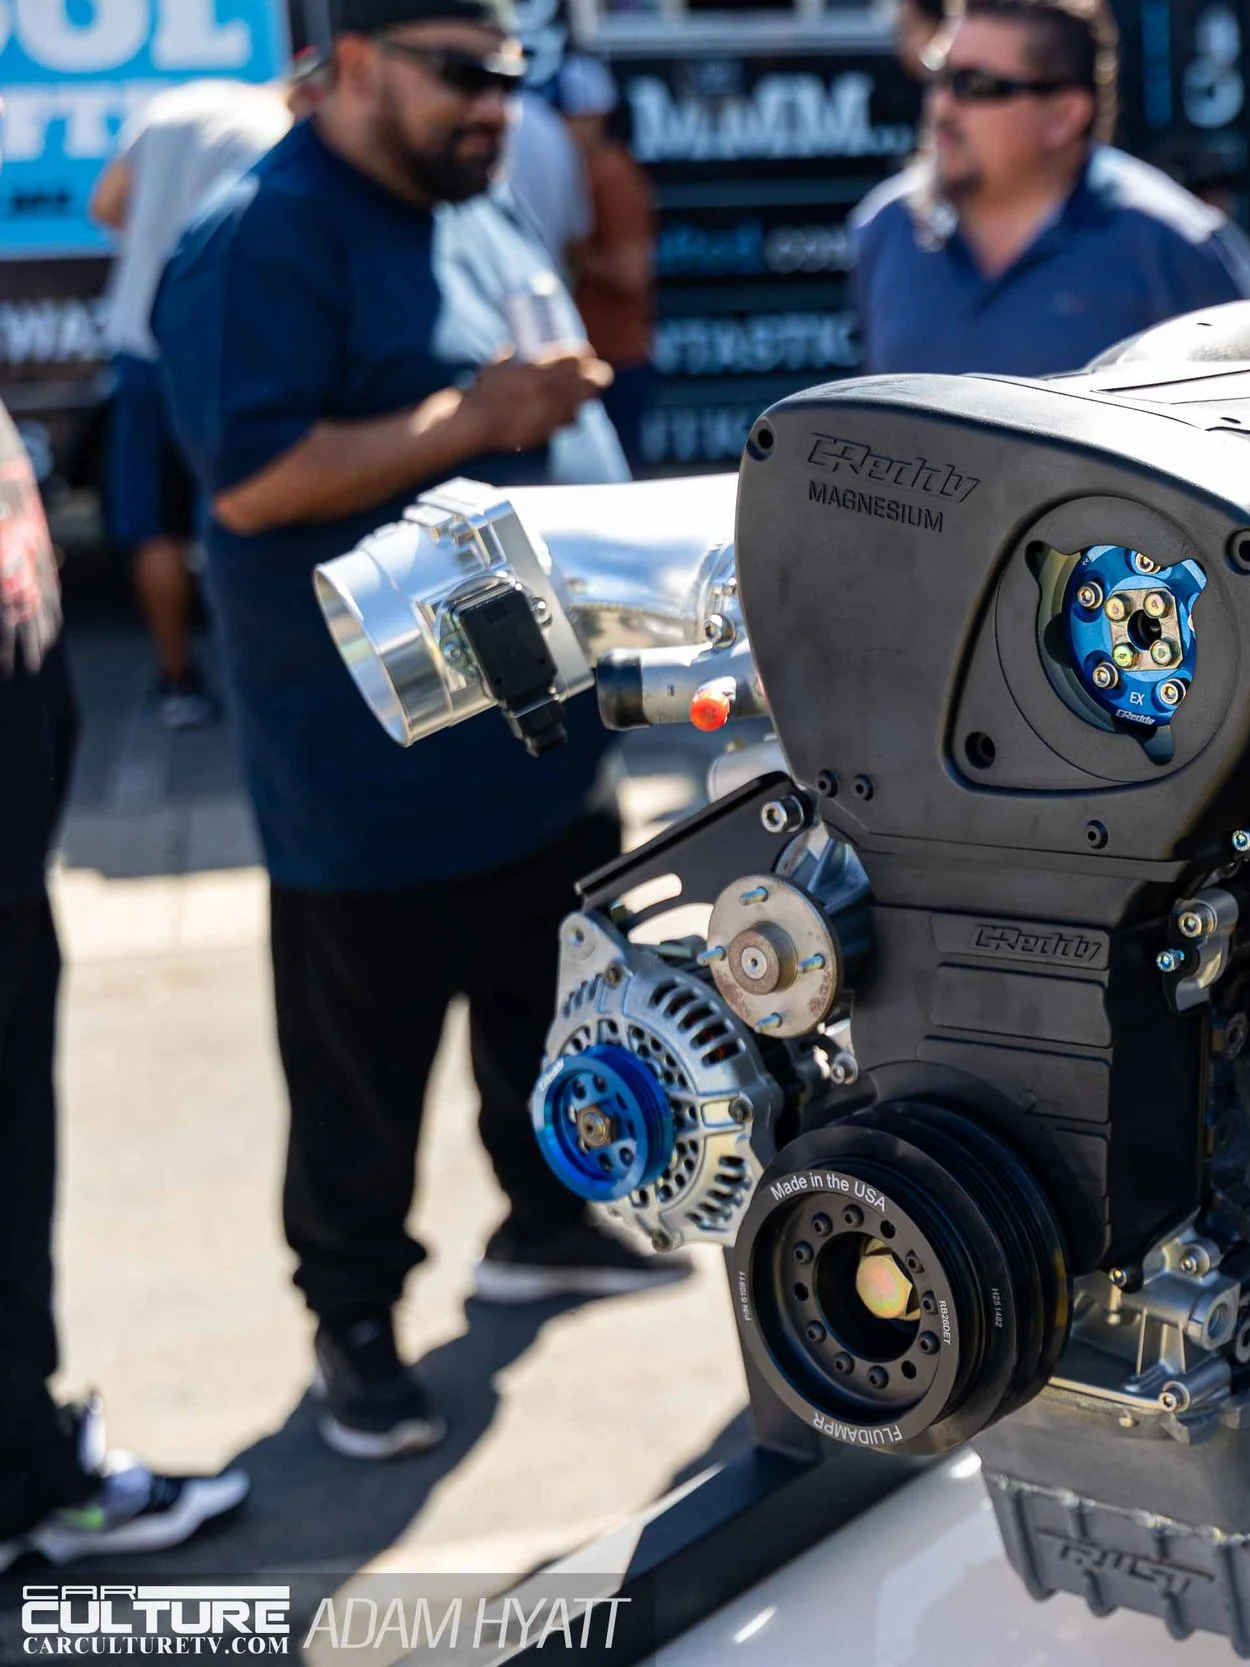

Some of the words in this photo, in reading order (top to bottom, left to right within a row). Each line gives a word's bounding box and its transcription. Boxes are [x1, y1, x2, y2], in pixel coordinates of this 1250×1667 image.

[807, 432, 980, 503] GReddy
[808, 480, 944, 533] MAGNESIUM
[1115, 709, 1156, 726] GReddy
[1129, 691, 1145, 706] EX
[975, 923, 1102, 962] GReddy
[770, 1175, 808, 1201] Made
[809, 1172, 824, 1188] in
[826, 1173, 850, 1192] the
[854, 1181, 886, 1213] USA
[813, 1411, 903, 1445] FLUIDAMPR
